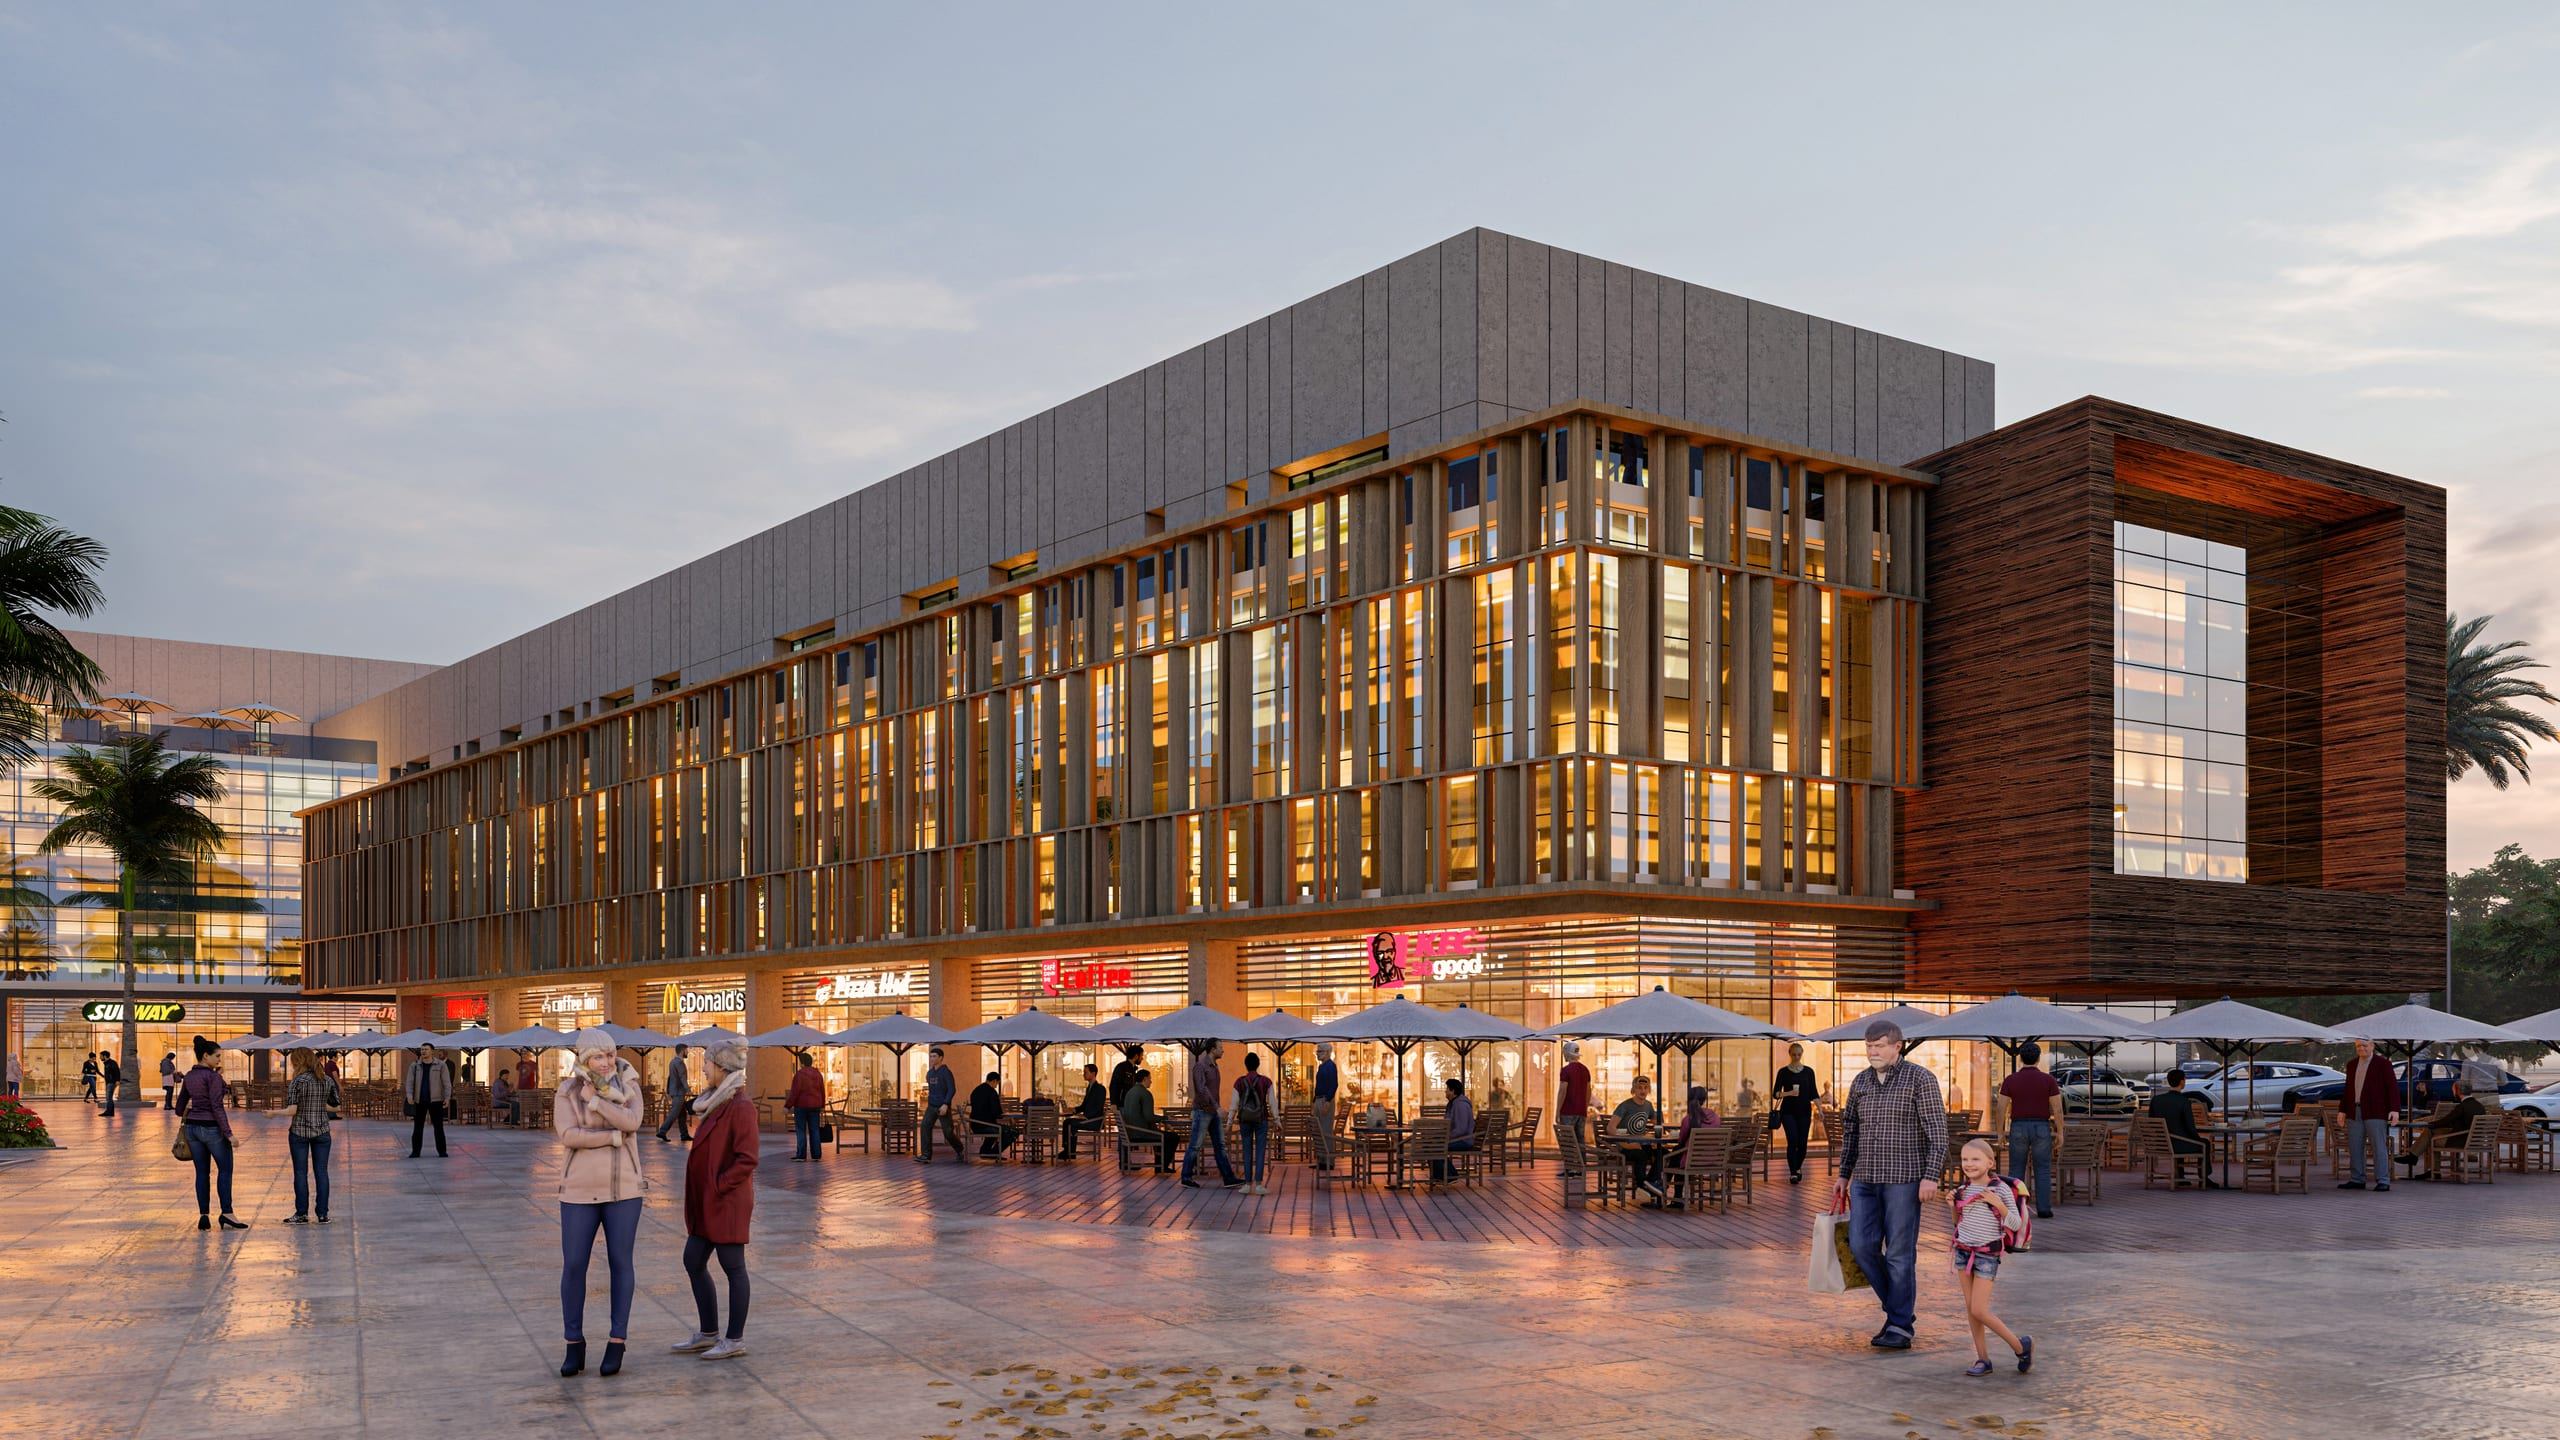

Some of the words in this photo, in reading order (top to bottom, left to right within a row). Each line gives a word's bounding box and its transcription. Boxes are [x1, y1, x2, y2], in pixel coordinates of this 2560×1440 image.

[1416, 931, 1476, 957] KFC
[1063, 963, 1131, 988] coffee
[1432, 953, 1482, 980] good
[552, 994, 582, 1012] coffee
[584, 991, 598, 1011] inn
[662, 983, 745, 1014] McDonald's
[87, 1003, 181, 1021] SUWAY
